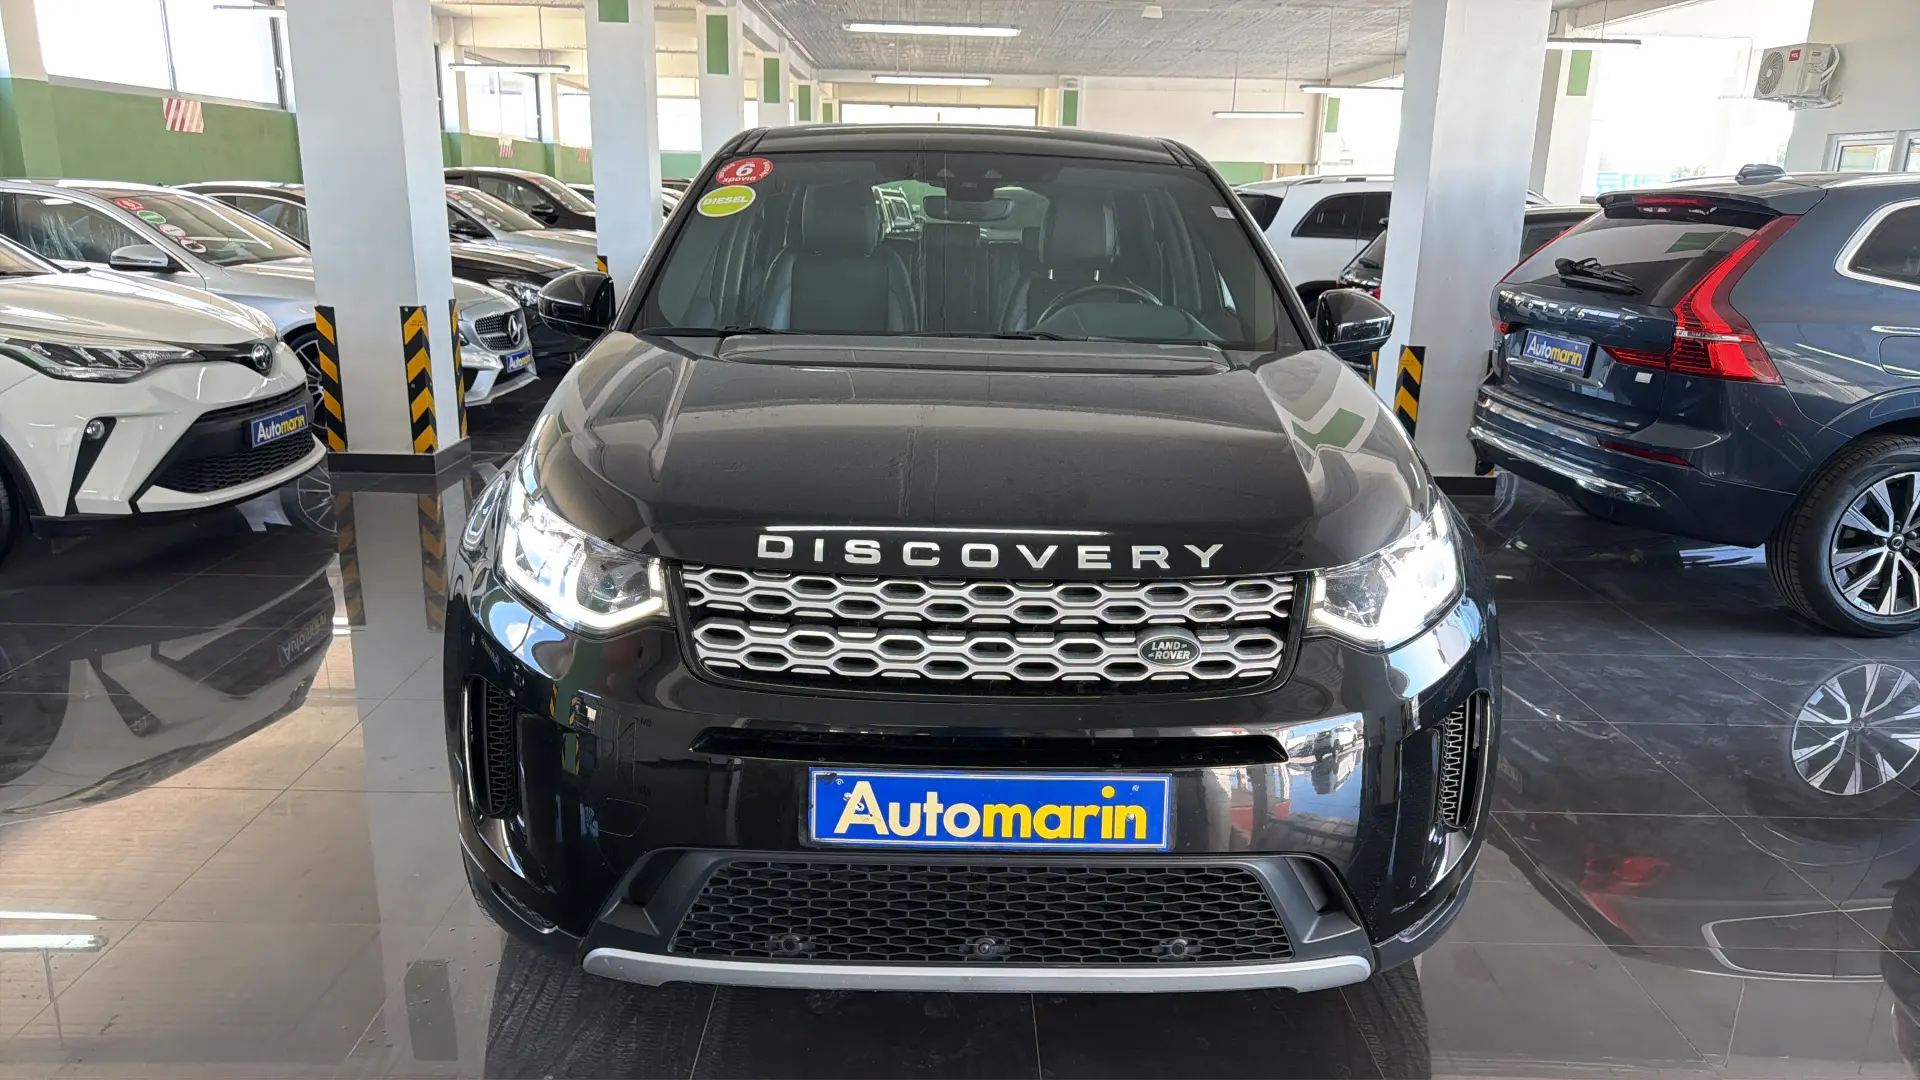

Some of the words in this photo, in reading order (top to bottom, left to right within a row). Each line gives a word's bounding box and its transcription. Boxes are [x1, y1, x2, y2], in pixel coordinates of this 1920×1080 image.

[736, 164, 756, 177] 6
[703, 196, 748, 206] DIESEL
[1526, 335, 1583, 366] Automarin
[257, 410, 306, 443] Automarin
[757, 534, 1224, 569] DISCOVERY
[1151, 642, 1180, 650] LAND
[1154, 651, 1190, 659] ROVER
[833, 780, 1148, 840] Automarin
